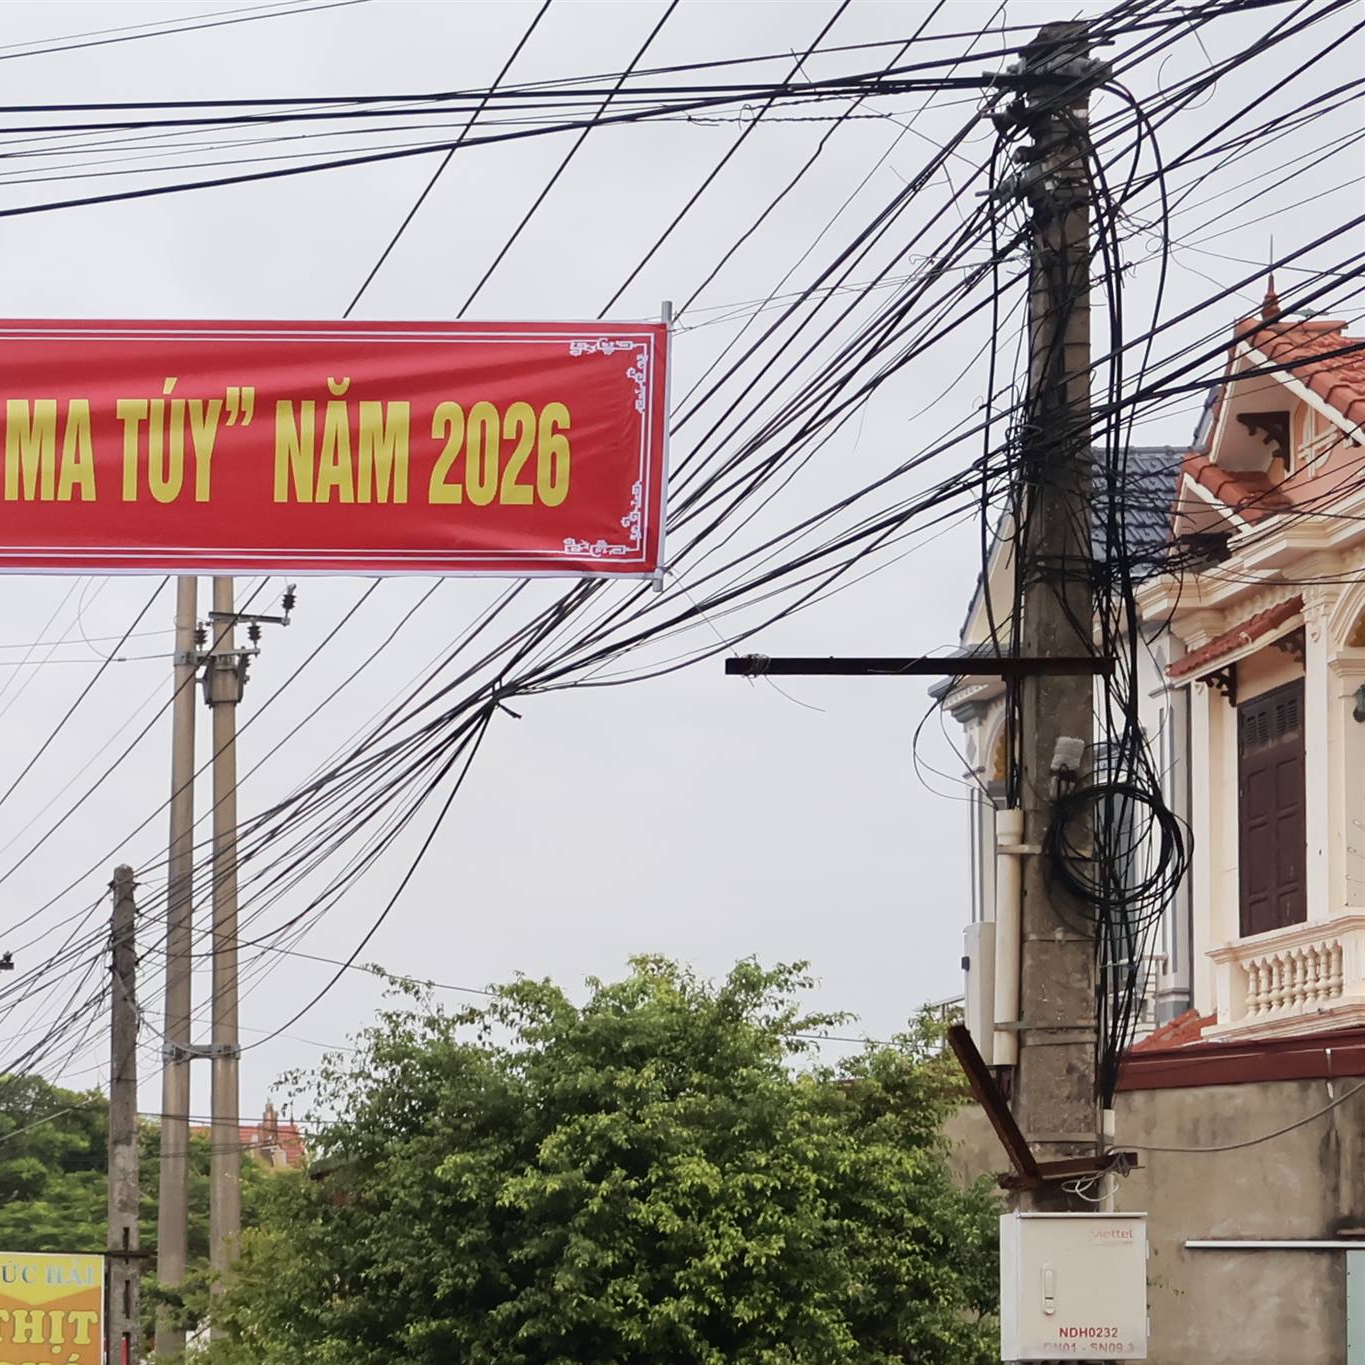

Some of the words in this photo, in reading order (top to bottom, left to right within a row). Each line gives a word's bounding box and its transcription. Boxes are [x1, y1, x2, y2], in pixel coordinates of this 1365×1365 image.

[4, 399, 97, 502] MA
[273, 377, 411, 504] NĂM
[428, 400, 571, 507] 2026
[1059, 1327, 1118, 1338] NDH0232
